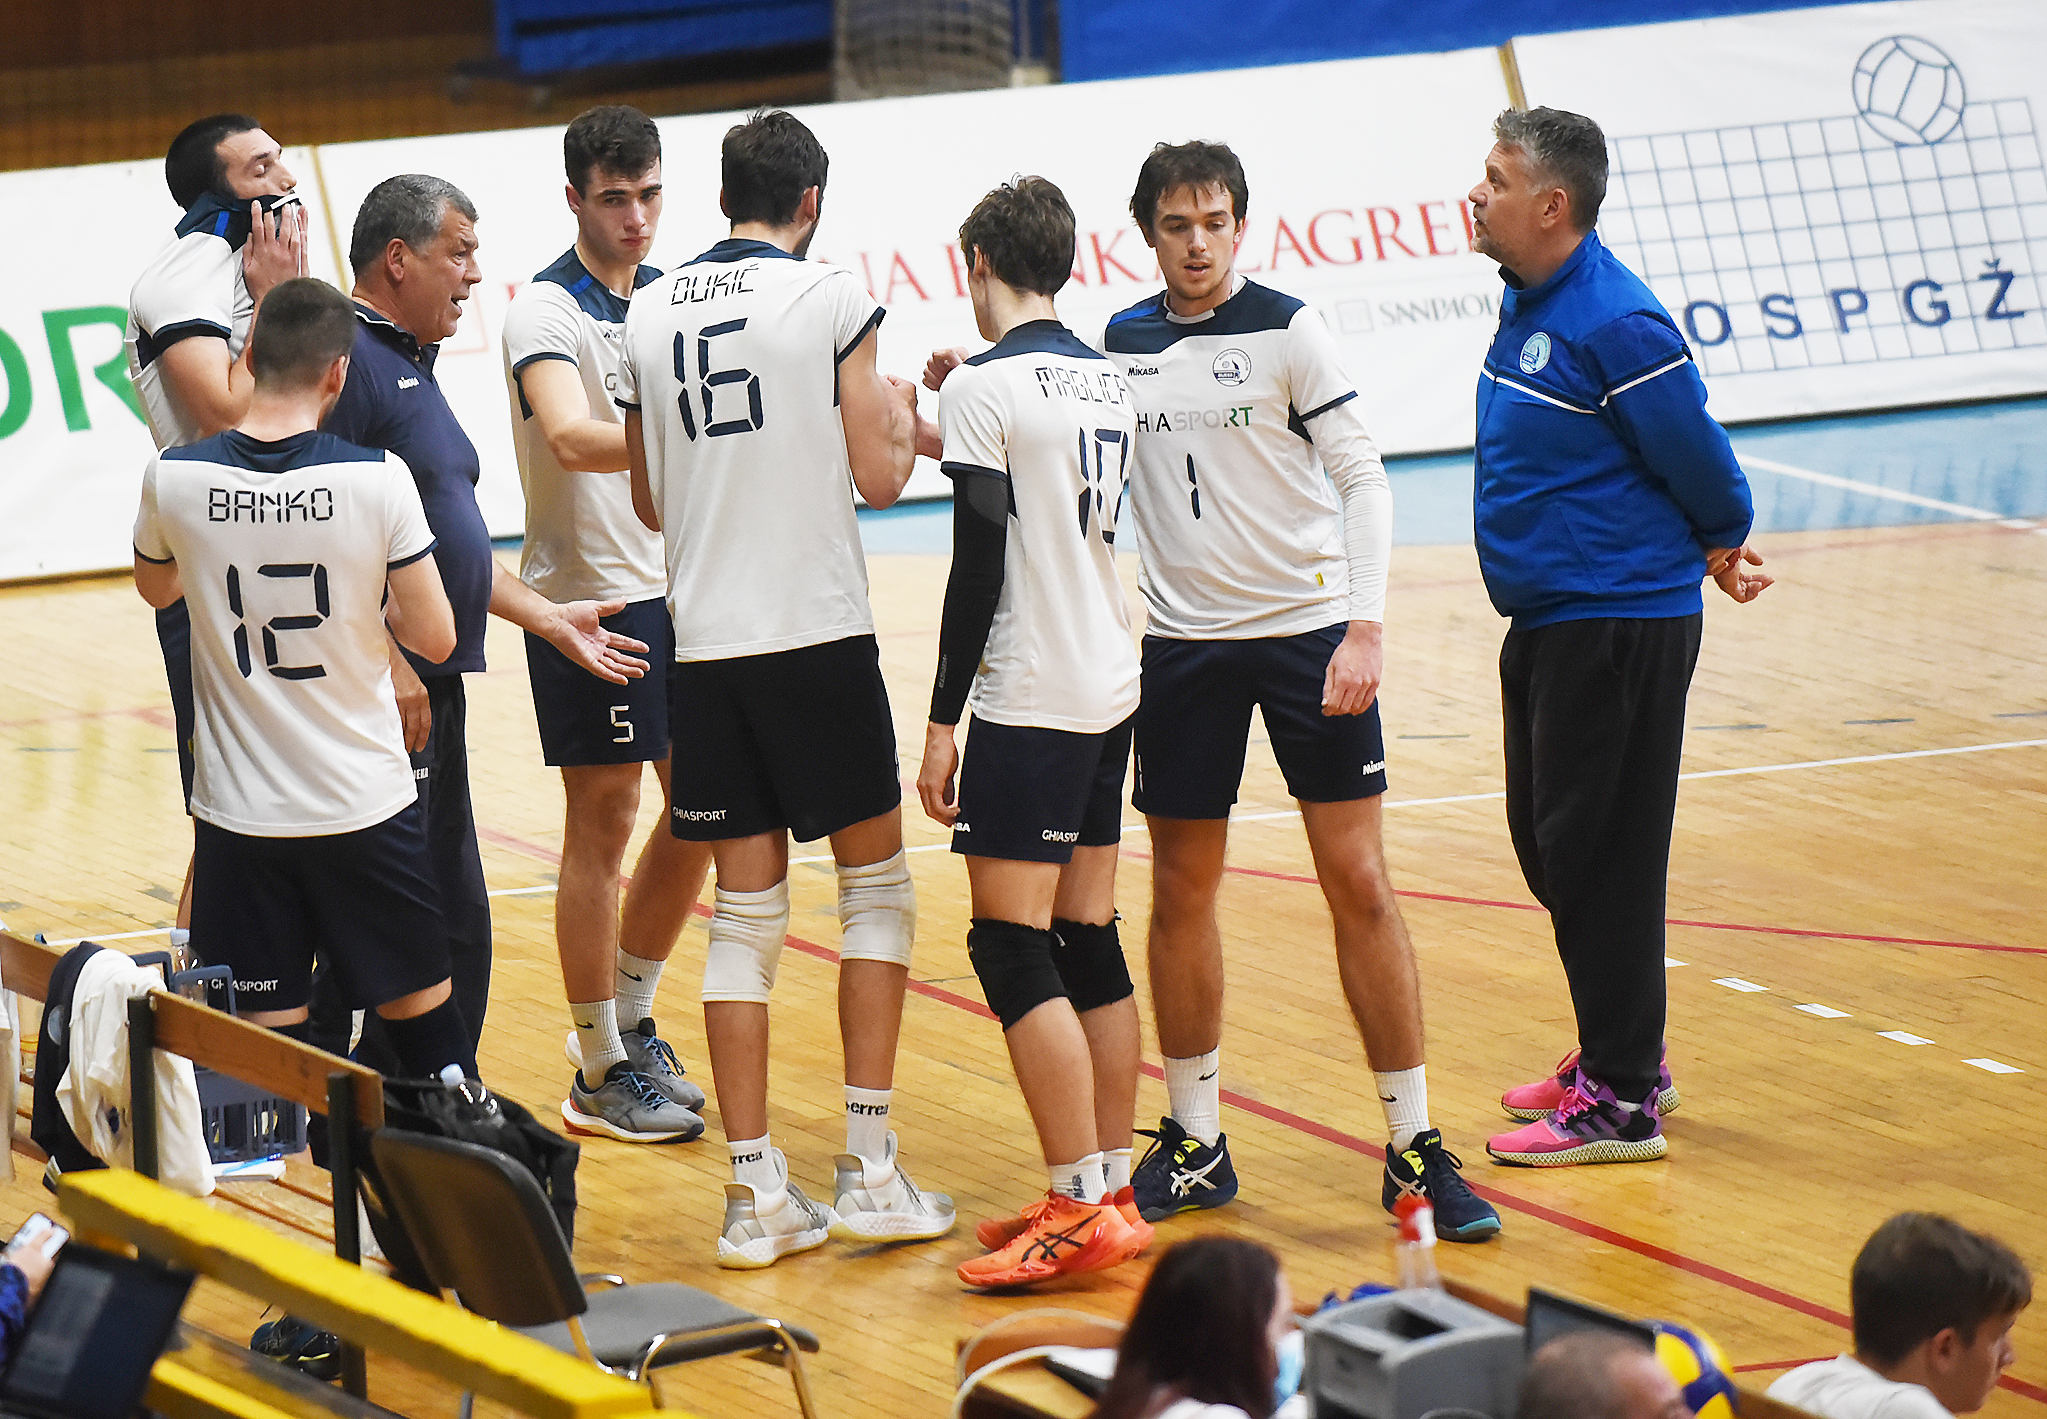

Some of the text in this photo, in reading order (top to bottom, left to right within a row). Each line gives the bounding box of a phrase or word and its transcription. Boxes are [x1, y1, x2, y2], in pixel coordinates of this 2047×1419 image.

[1379, 293, 1501, 326] SANPAOL
[673, 317, 764, 442] 16
[1136, 406, 1254, 433] HIASPORT
[1078, 427, 1129, 545] 10
[1187, 453, 1201, 520] 1
[208, 487, 334, 524] BANKO
[226, 563, 331, 681] 12
[610, 705, 634, 743] 5
[211, 979, 279, 992] GHASPORT
